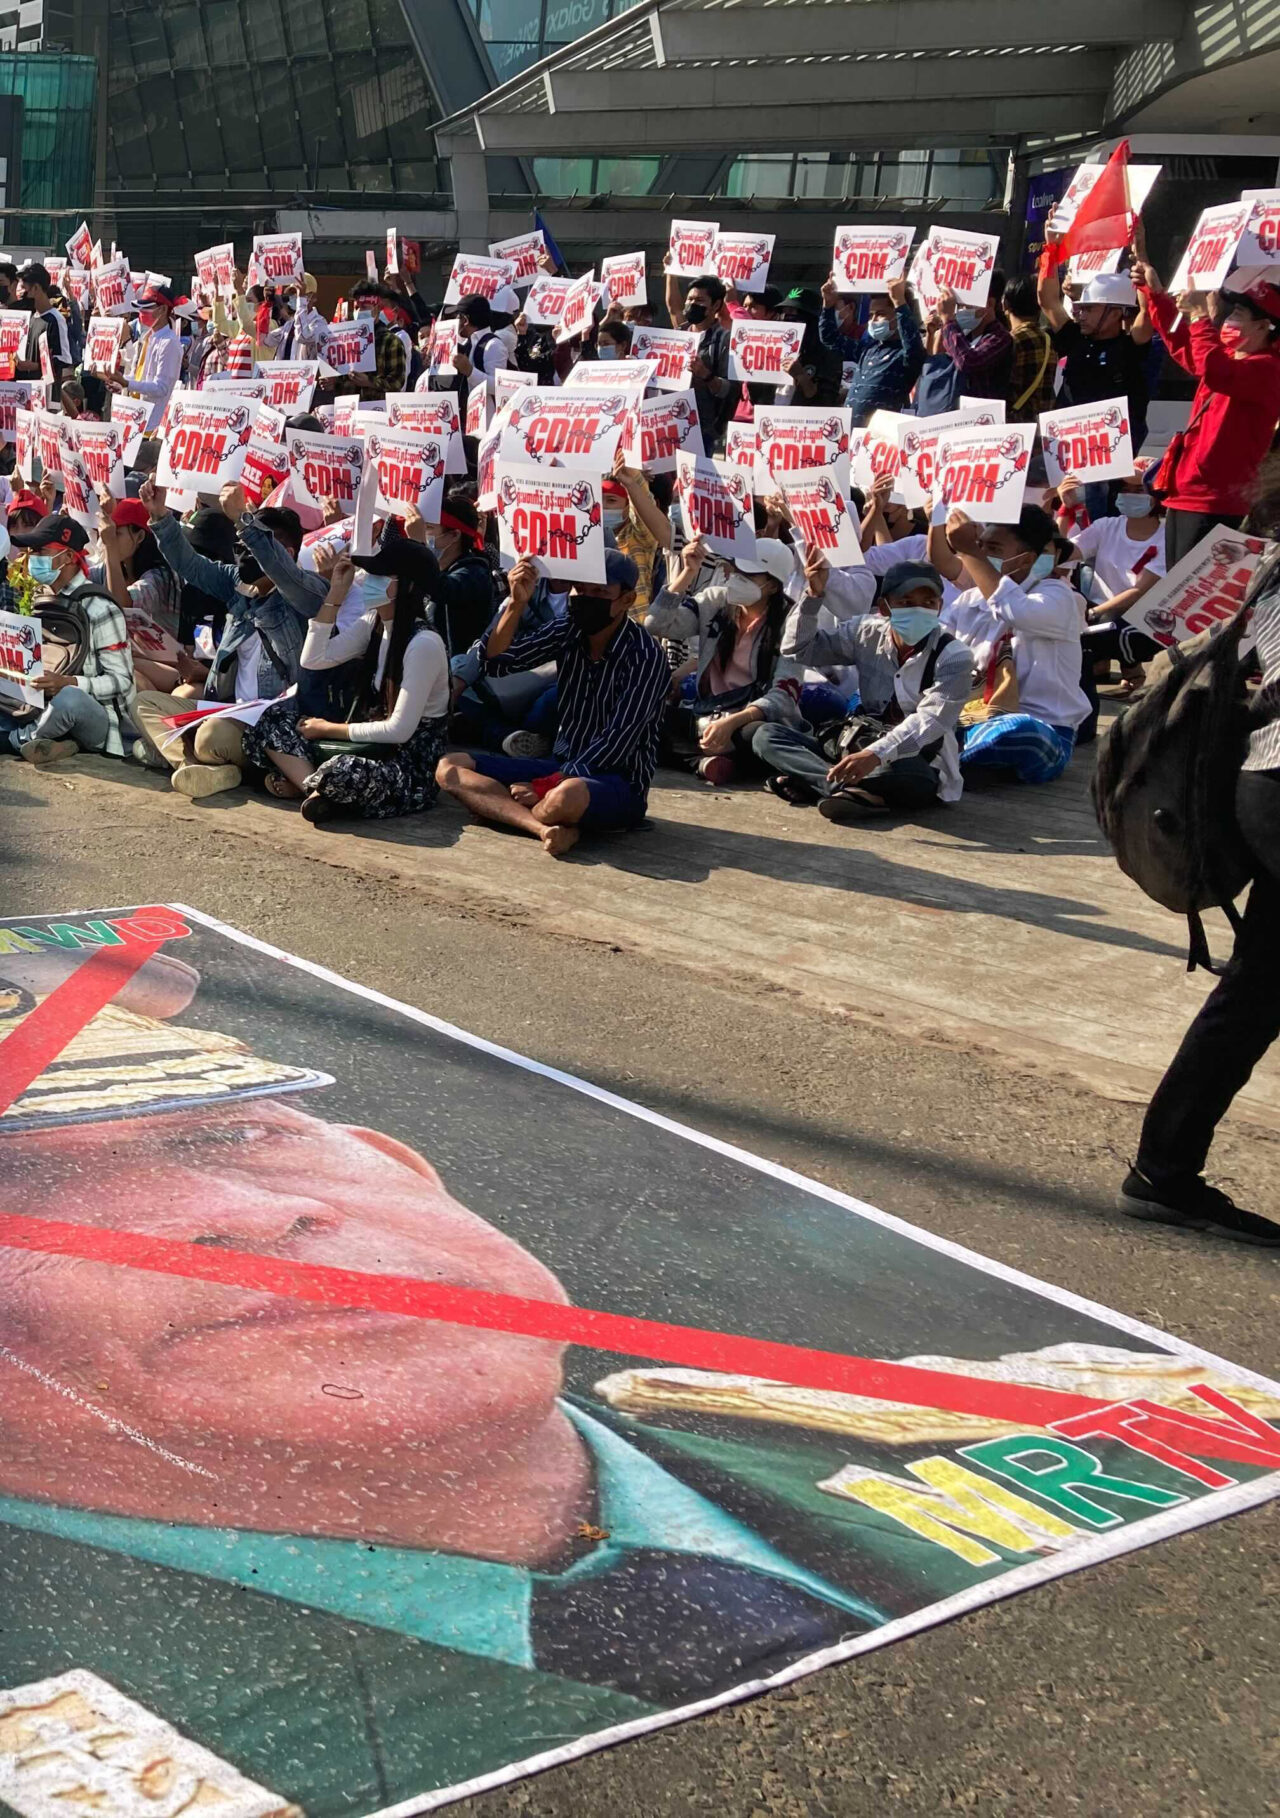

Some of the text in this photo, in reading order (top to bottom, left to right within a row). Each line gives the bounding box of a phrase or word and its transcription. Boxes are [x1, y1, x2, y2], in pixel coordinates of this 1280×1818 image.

[264, 255, 294, 277] CDM
[515, 254, 538, 278] DM
[678, 242, 704, 267] CDM
[717, 255, 754, 280] CDM
[845, 252, 888, 280] CDM
[1187, 237, 1228, 275] CDM
[459, 275, 498, 299] CDM
[609, 275, 635, 300] CDM
[933, 256, 976, 291] CDM
[99, 282, 125, 312] CDM
[564, 297, 585, 329] CDM
[92, 338, 114, 363] CDM
[327, 340, 361, 366] CDM
[741, 345, 782, 372] CDM
[525, 418, 600, 454] CDM
[82, 450, 110, 483] CDM
[169, 429, 228, 475] CDM
[770, 442, 826, 471] CDM
[1057, 432, 1112, 472] CDM
[304, 462, 354, 500] CDM
[377, 460, 423, 504] CDM
[942, 463, 1000, 506] CDM
[688, 492, 735, 540] CDM
[61, 528, 71, 543] 3
[512, 508, 578, 560] CDM
[842, 1383, 1280, 1567] MRTV
